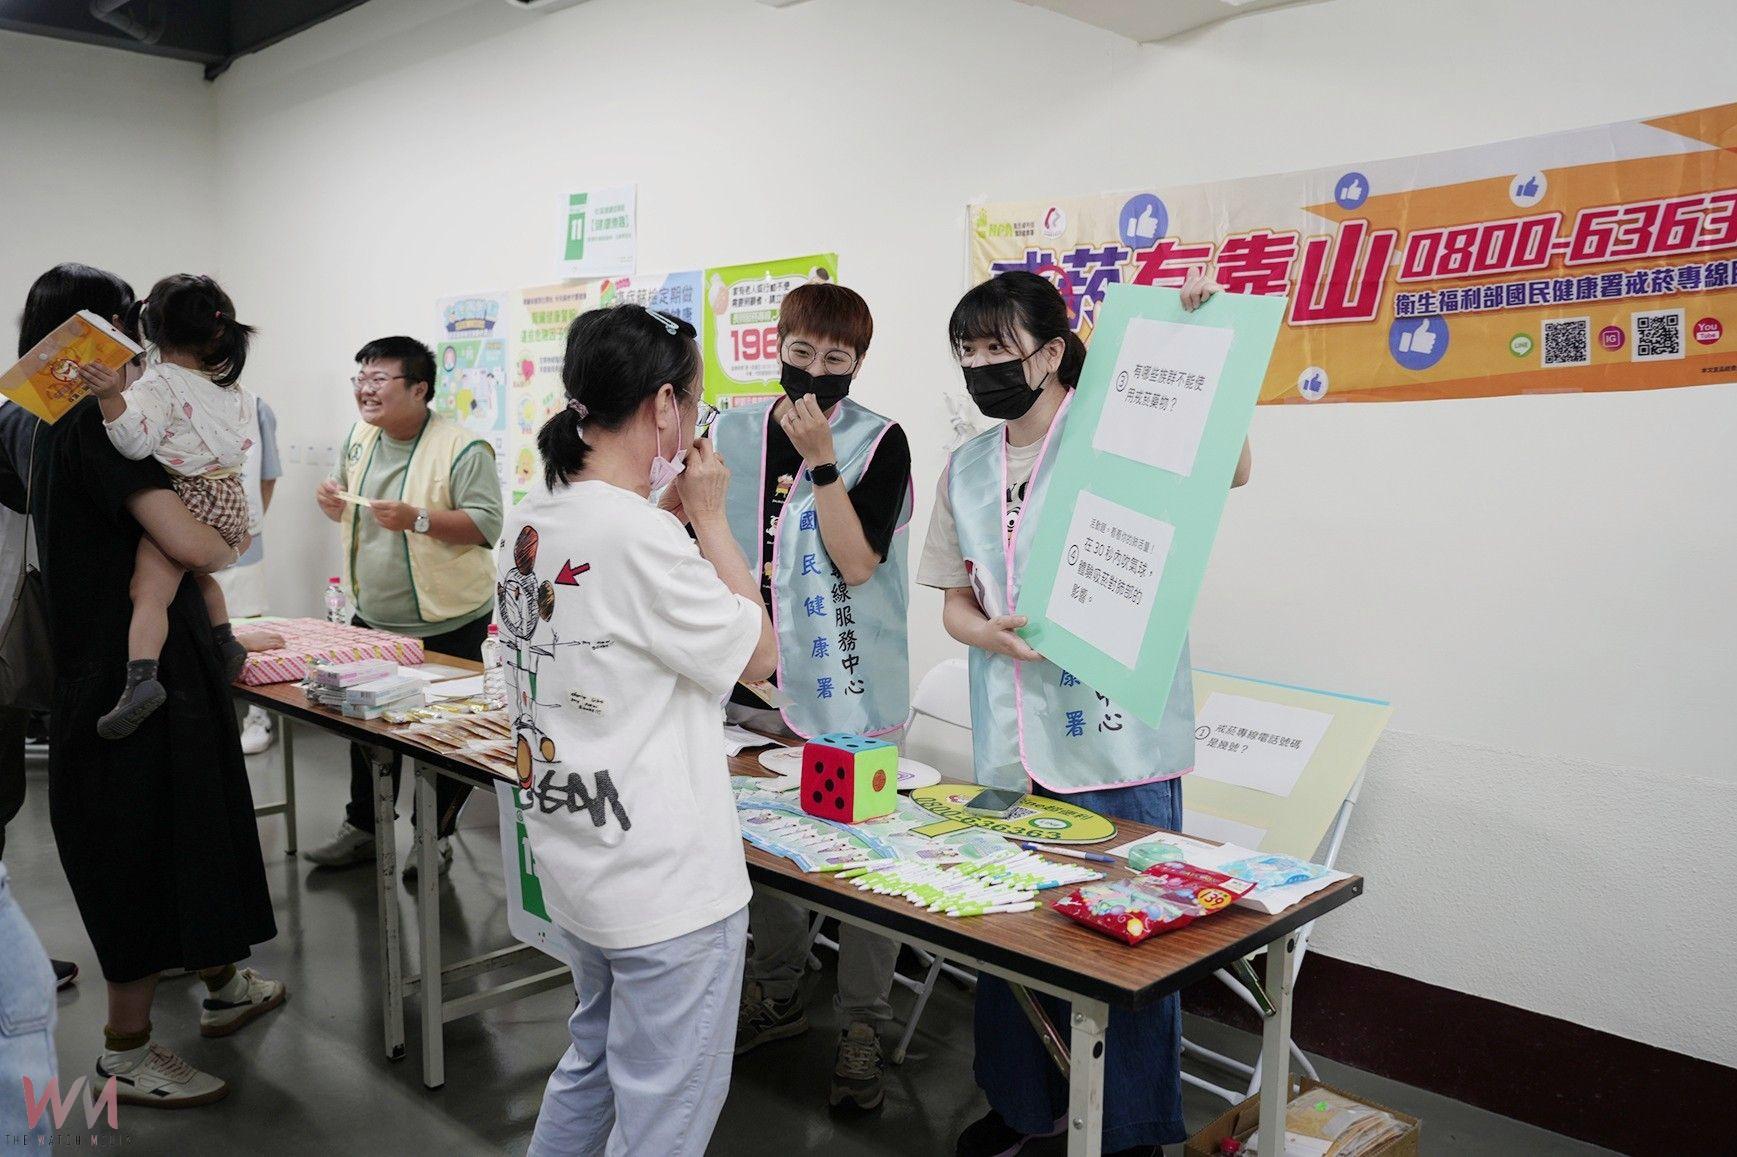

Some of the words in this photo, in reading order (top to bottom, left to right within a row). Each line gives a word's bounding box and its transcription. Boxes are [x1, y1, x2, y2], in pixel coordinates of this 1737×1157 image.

[1605, 334, 1616, 343] IG
[1698, 322, 1717, 332] You
[800, 510, 834, 699] 國民健康署
[827, 553, 865, 696] 線服務中心
[1215, 724, 1303, 750] 戒菸專線電話號碼
